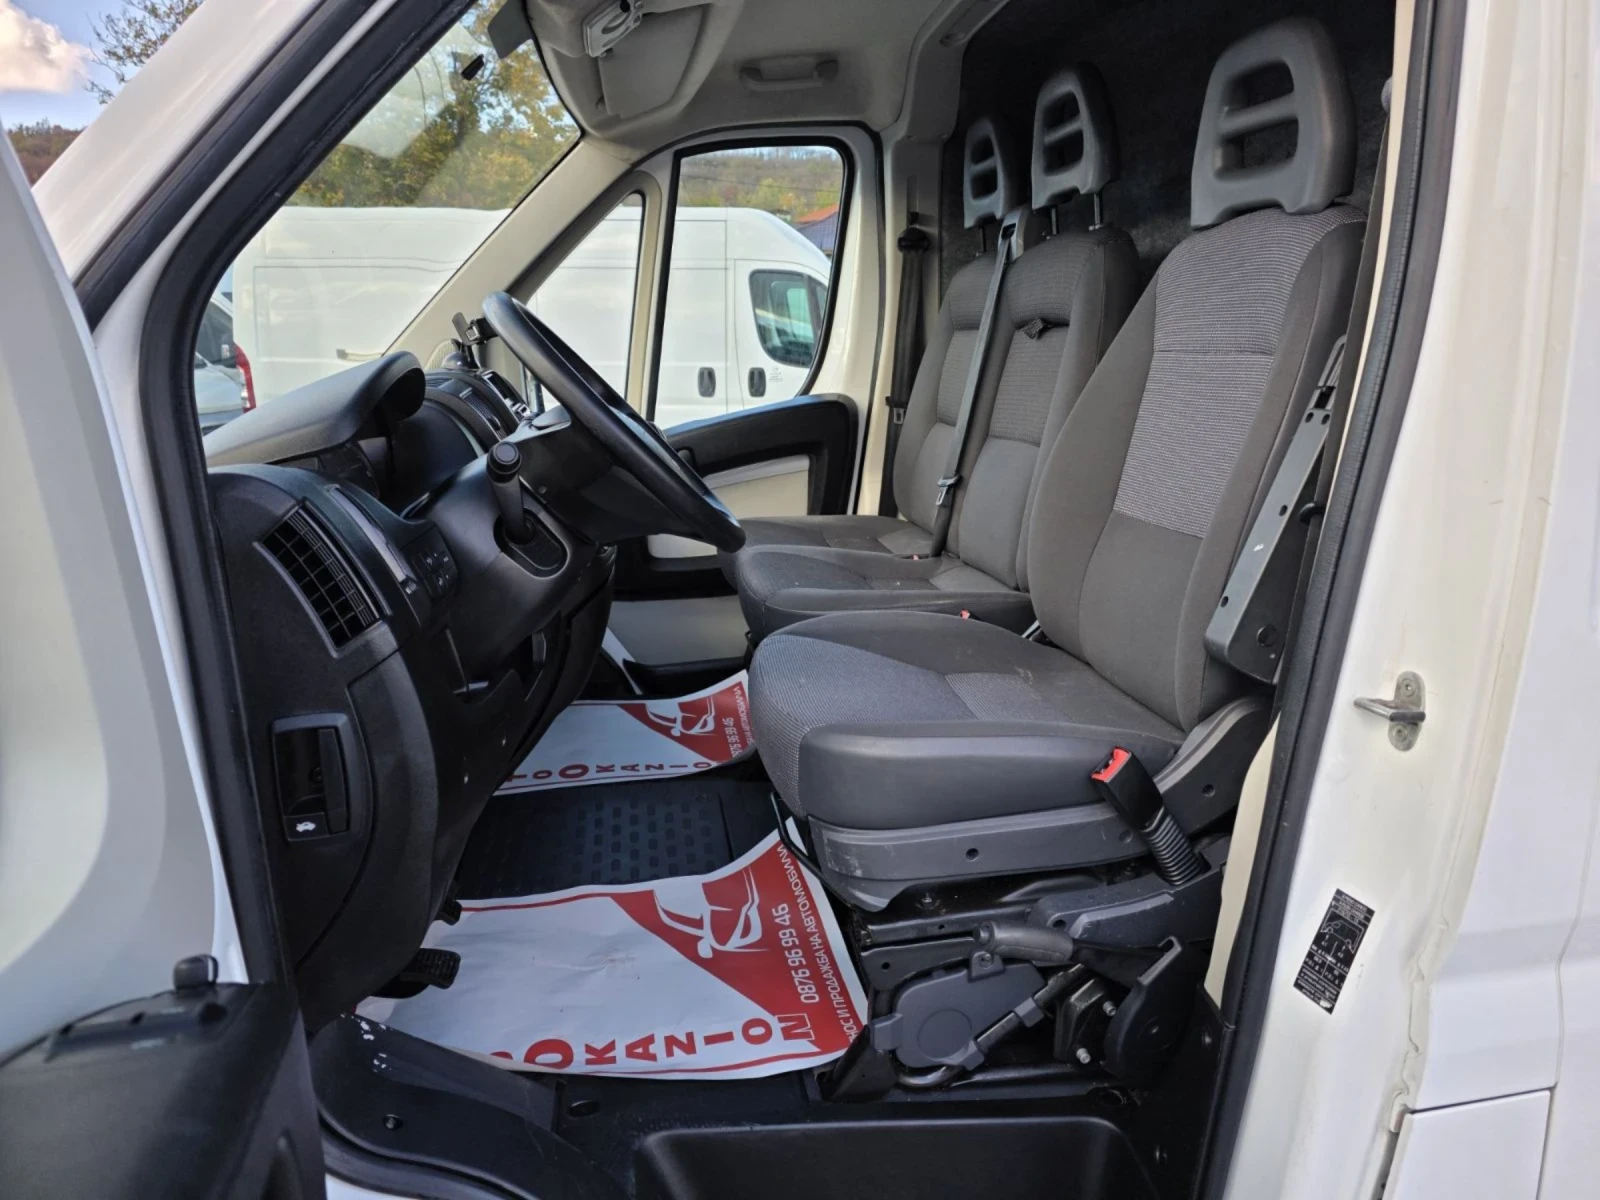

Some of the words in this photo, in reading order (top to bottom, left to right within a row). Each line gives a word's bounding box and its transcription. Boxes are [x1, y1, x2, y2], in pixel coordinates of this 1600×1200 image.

[777, 844, 819, 933] АВТОМОБИЛИ
[772, 903, 792, 926] 46
[778, 927, 800, 947] 99
[809, 933, 824, 950] НА
[784, 948, 807, 967] 96
[791, 968, 820, 1004] 0876
[814, 949, 847, 1008] ПРОДАЖБА
[836, 1008, 851, 1018] И
[840, 1018, 860, 1043] НОС
